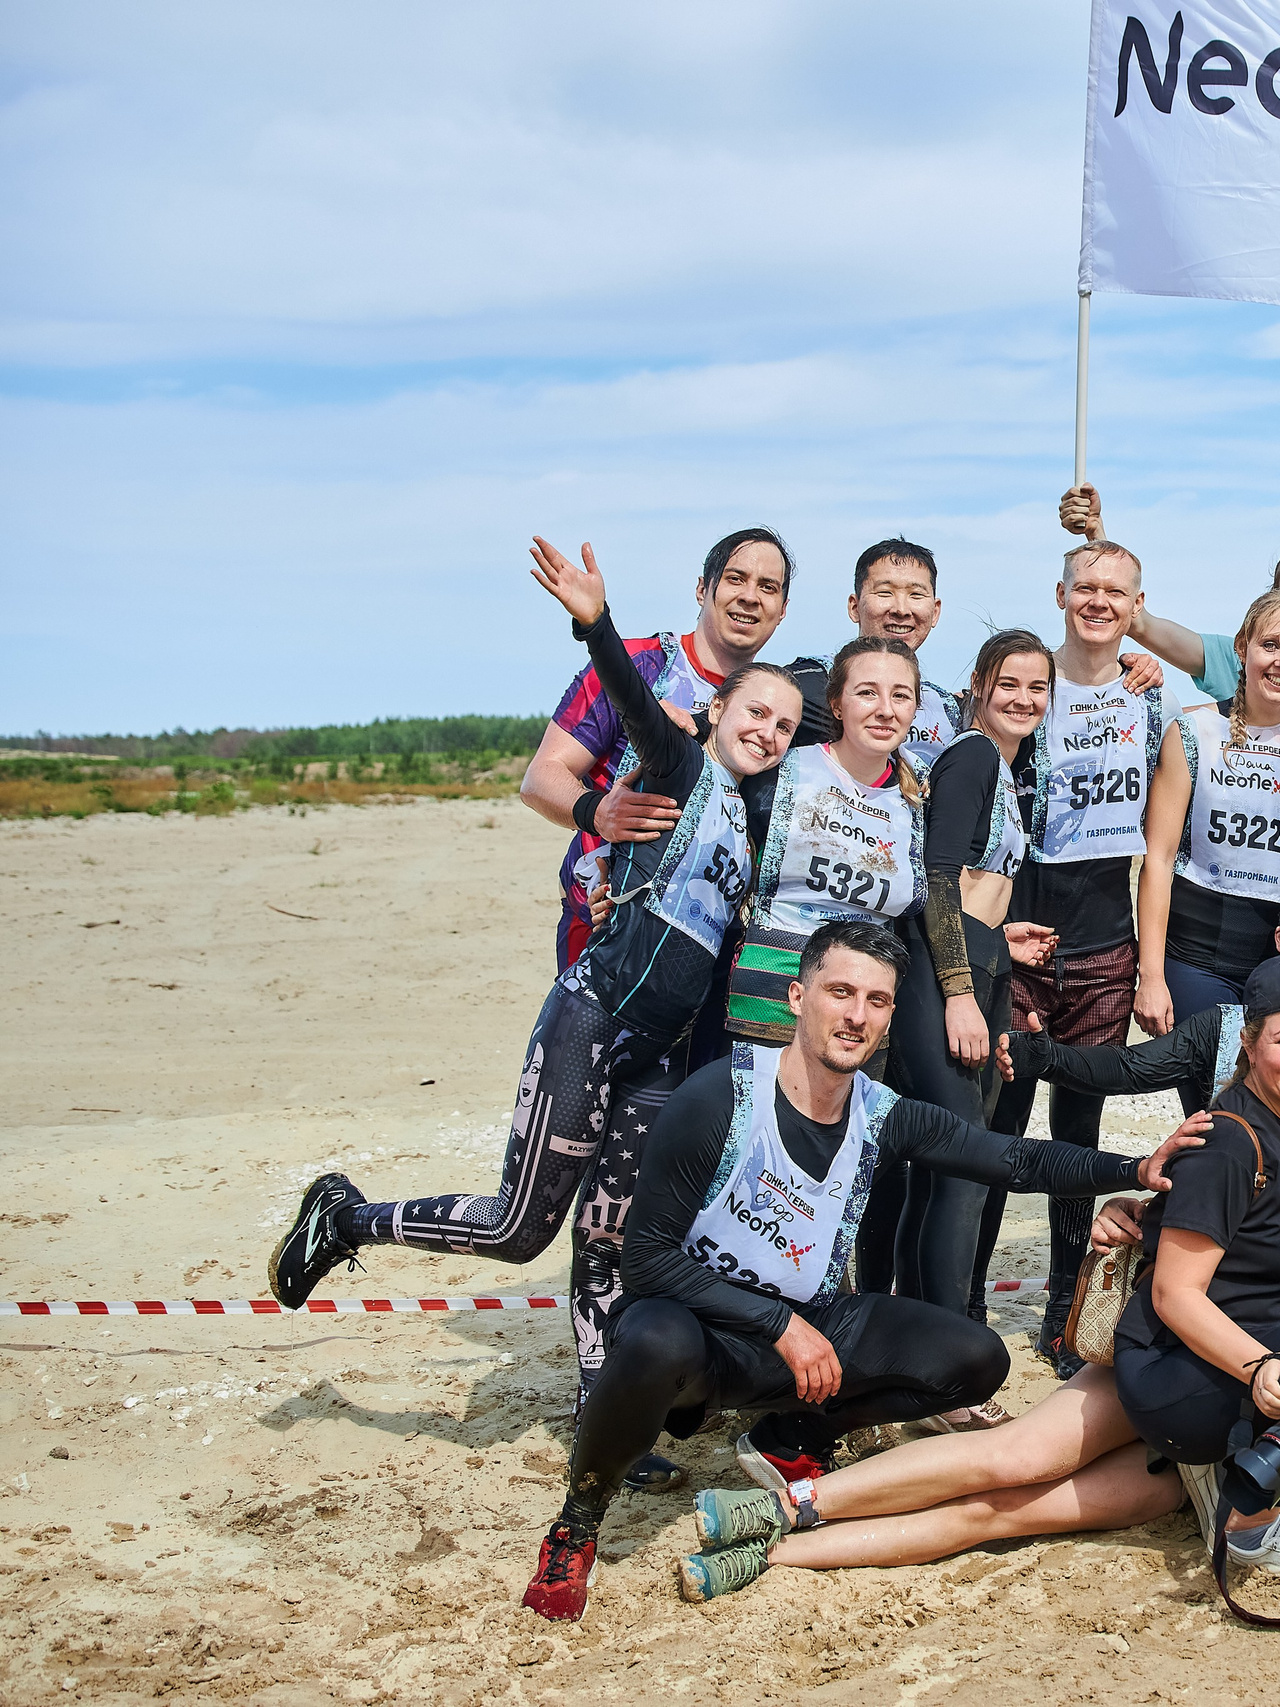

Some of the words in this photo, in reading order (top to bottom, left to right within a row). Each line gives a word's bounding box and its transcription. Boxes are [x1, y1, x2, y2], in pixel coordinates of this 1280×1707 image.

[693, 700, 711, 708] ГОН
[1070, 703, 1099, 712] ГОНКА
[830, 785, 856, 807] ГОНКА
[856, 802, 891, 820] ГЕРОЕВ
[1069, 766, 1141, 811] 5326
[1086, 825, 1138, 838] ГАЗПРОМБАНК
[805, 855, 890, 911] 5321
[1224, 869, 1279, 884] ГАЗПРОМБАНК
[760, 1169, 788, 1195] ГОНКА
[787, 1191, 815, 1217] ГЕРОЕВ
[828, 1180, 843, 1201] 2
[722, 1191, 816, 1272] Neoflex
